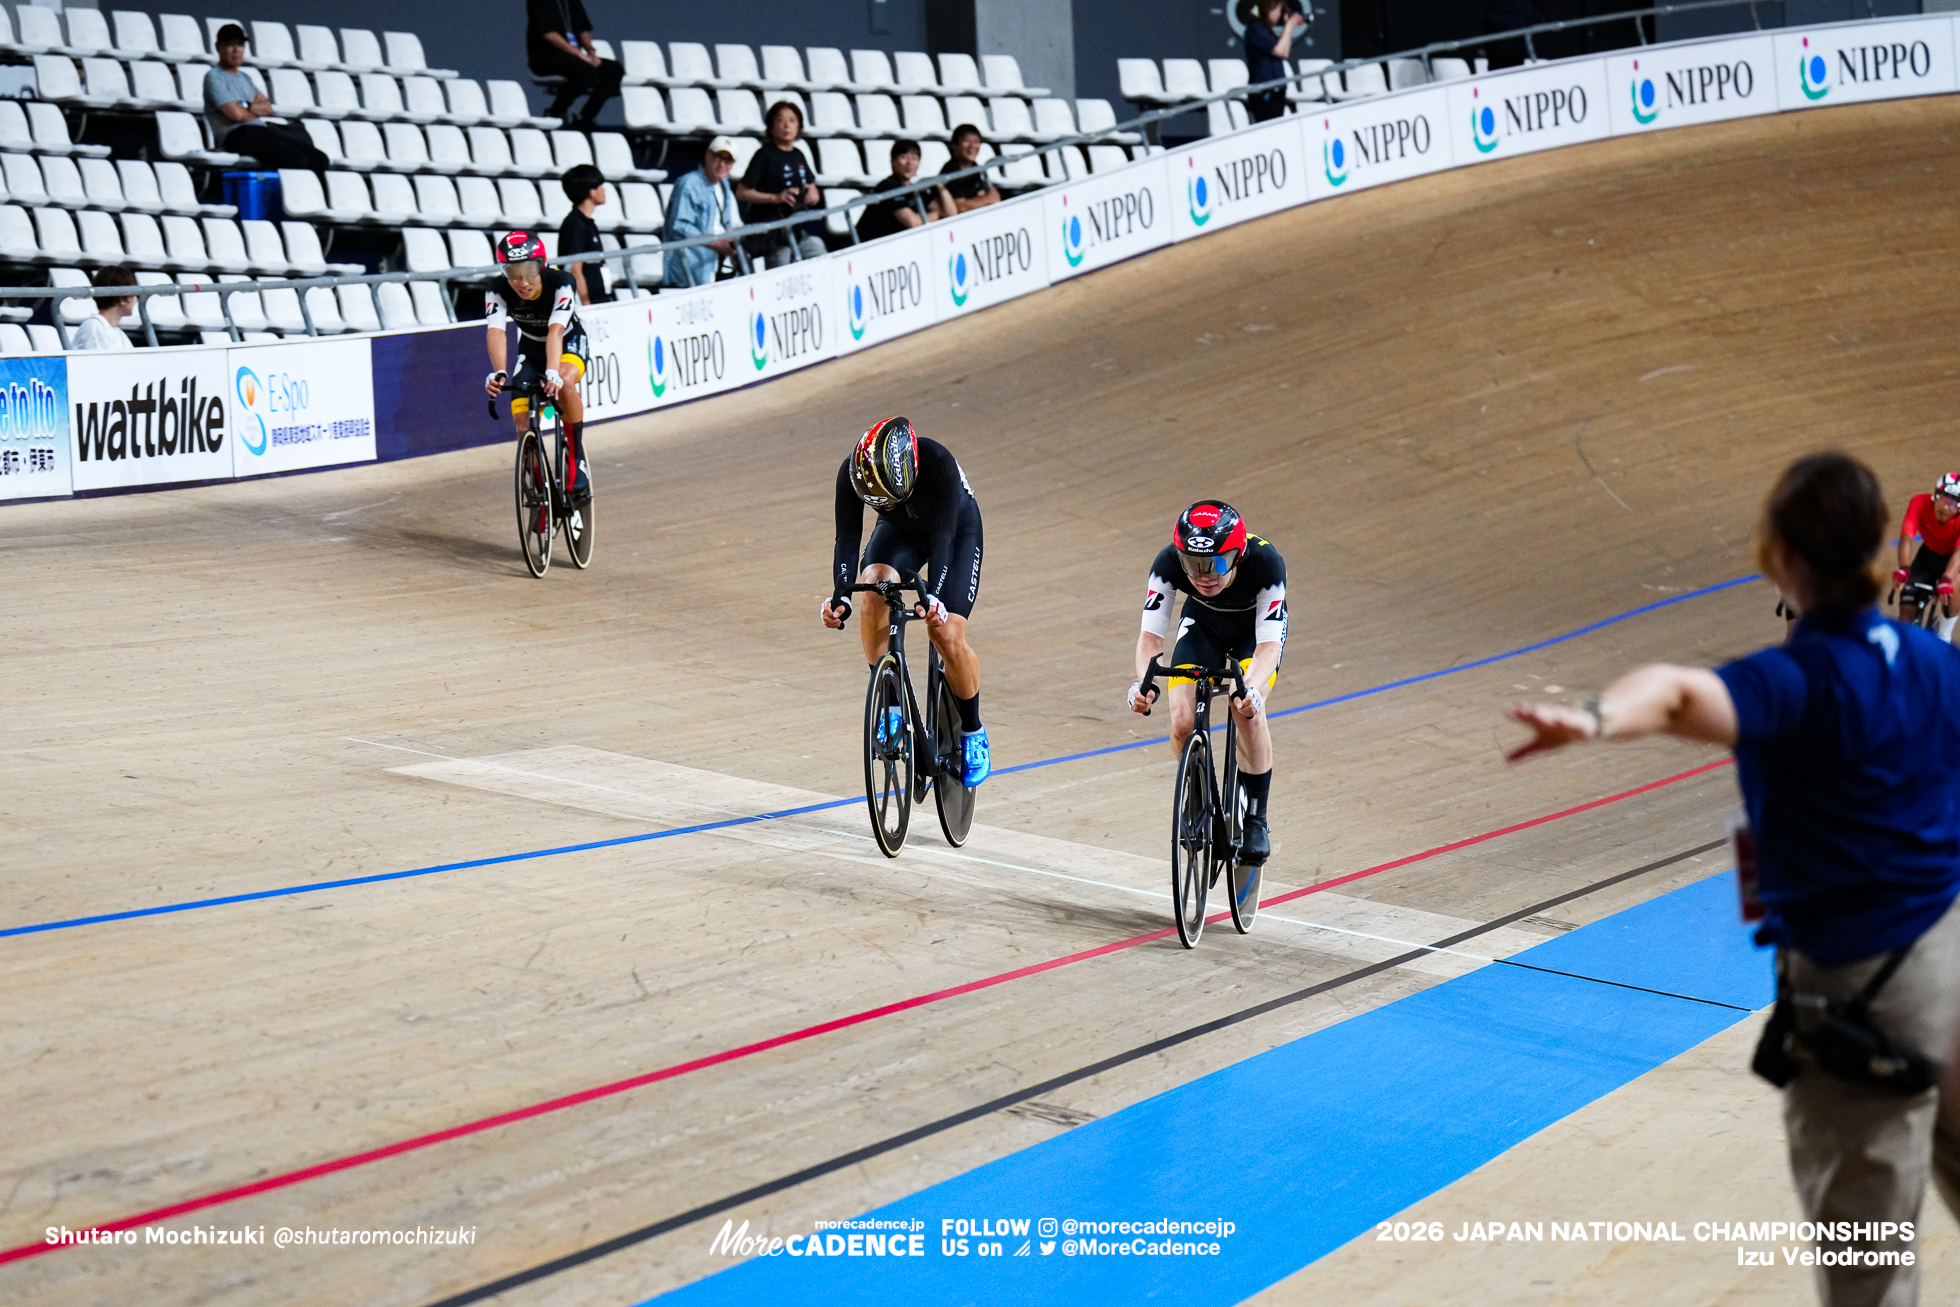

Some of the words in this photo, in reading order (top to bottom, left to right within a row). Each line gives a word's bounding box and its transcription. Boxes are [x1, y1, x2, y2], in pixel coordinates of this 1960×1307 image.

[1666, 60, 1754, 109] NIPPO
[1837, 40, 1931, 85] NIPPO
[1505, 85, 1588, 136] NIPPO
[1353, 115, 1432, 168] NIPPO
[1215, 148, 1287, 206] NIPPO
[1087, 186, 1154, 246] NIPPO
[970, 227, 1032, 286] NIPPO
[867, 261, 922, 320] NIPPO
[669, 329, 725, 391] NIPPO
[770, 302, 823, 363] NIPPO
[579, 352, 621, 409] PPO
[76, 376, 224, 462] wattbike
[891, 435, 903, 487] Kabuto
[935, 565, 949, 595] CASTELLI
[967, 546, 981, 603] CASTELLI
